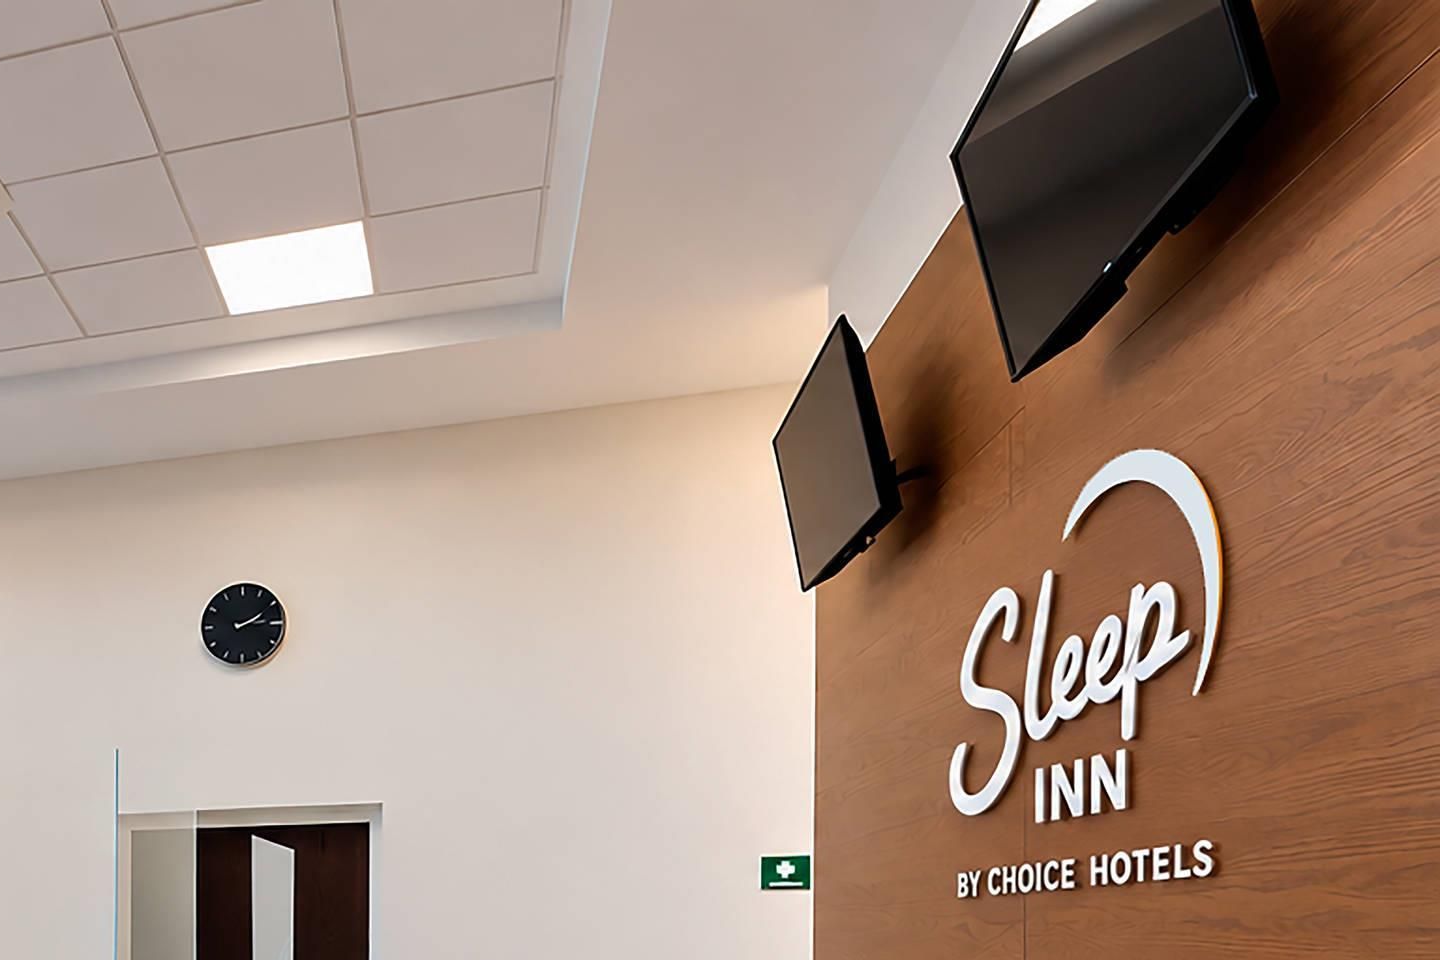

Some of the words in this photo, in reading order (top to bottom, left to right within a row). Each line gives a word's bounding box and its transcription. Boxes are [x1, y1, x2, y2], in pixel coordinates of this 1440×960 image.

[949, 569, 1192, 816] Sleep
[1034, 748, 1127, 824] INN
[957, 871, 981, 898] BY
[987, 858, 1076, 896] CHOICE
[1090, 839, 1214, 886] HOTELS
